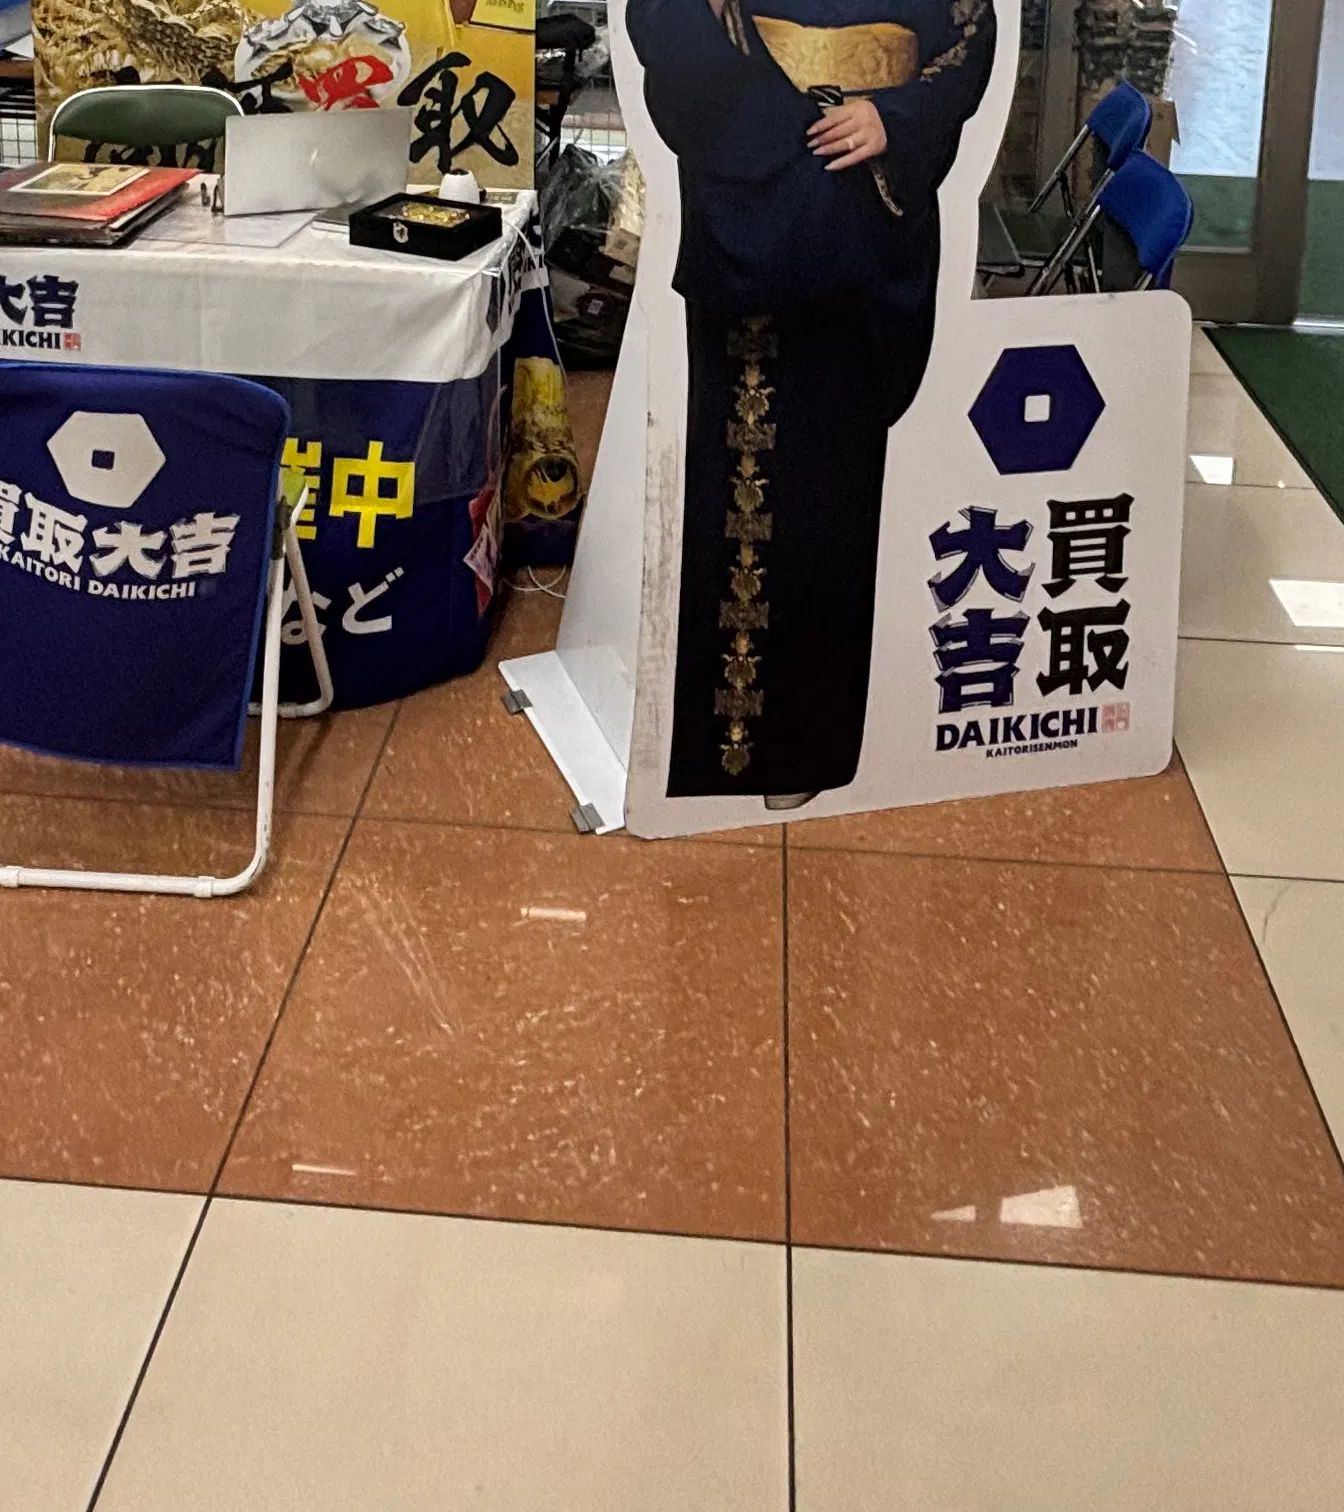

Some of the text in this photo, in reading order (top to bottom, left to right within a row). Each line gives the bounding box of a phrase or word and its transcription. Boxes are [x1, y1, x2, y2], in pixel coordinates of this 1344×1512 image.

[87, 571, 196, 601] DAIKICHI
[1036, 492, 1135, 697] 買取
[926, 504, 1036, 715] 大吉
[935, 706, 1099, 752] DAIKICHI
[985, 738, 1078, 759] KAITORISENMON
